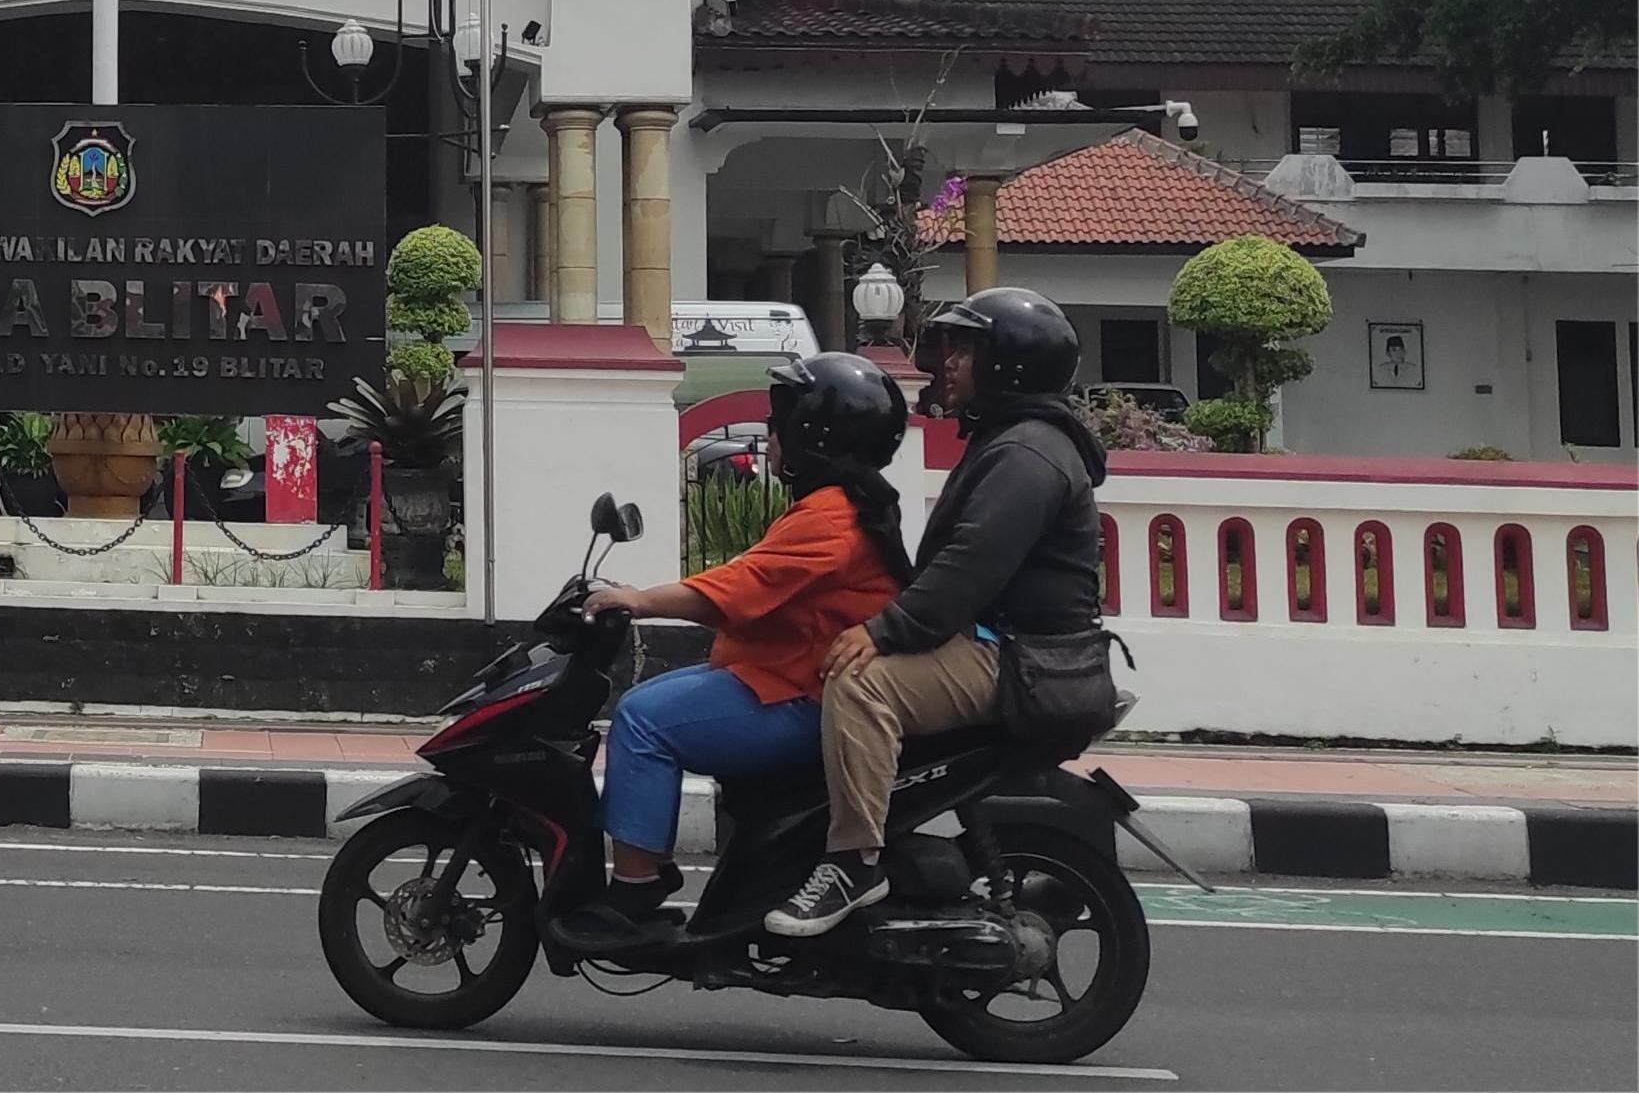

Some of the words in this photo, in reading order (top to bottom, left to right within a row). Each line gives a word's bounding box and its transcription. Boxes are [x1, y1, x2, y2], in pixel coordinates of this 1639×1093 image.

[134, 237, 246, 265] RAKYAT
[256, 238, 375, 267] DAERAH
[71, 279, 347, 343] BLITAR
[40, 353, 108, 376] YANI
[120, 355, 166, 377] No.
[173, 356, 209, 377] 19
[220, 357, 325, 380] BLITAR
